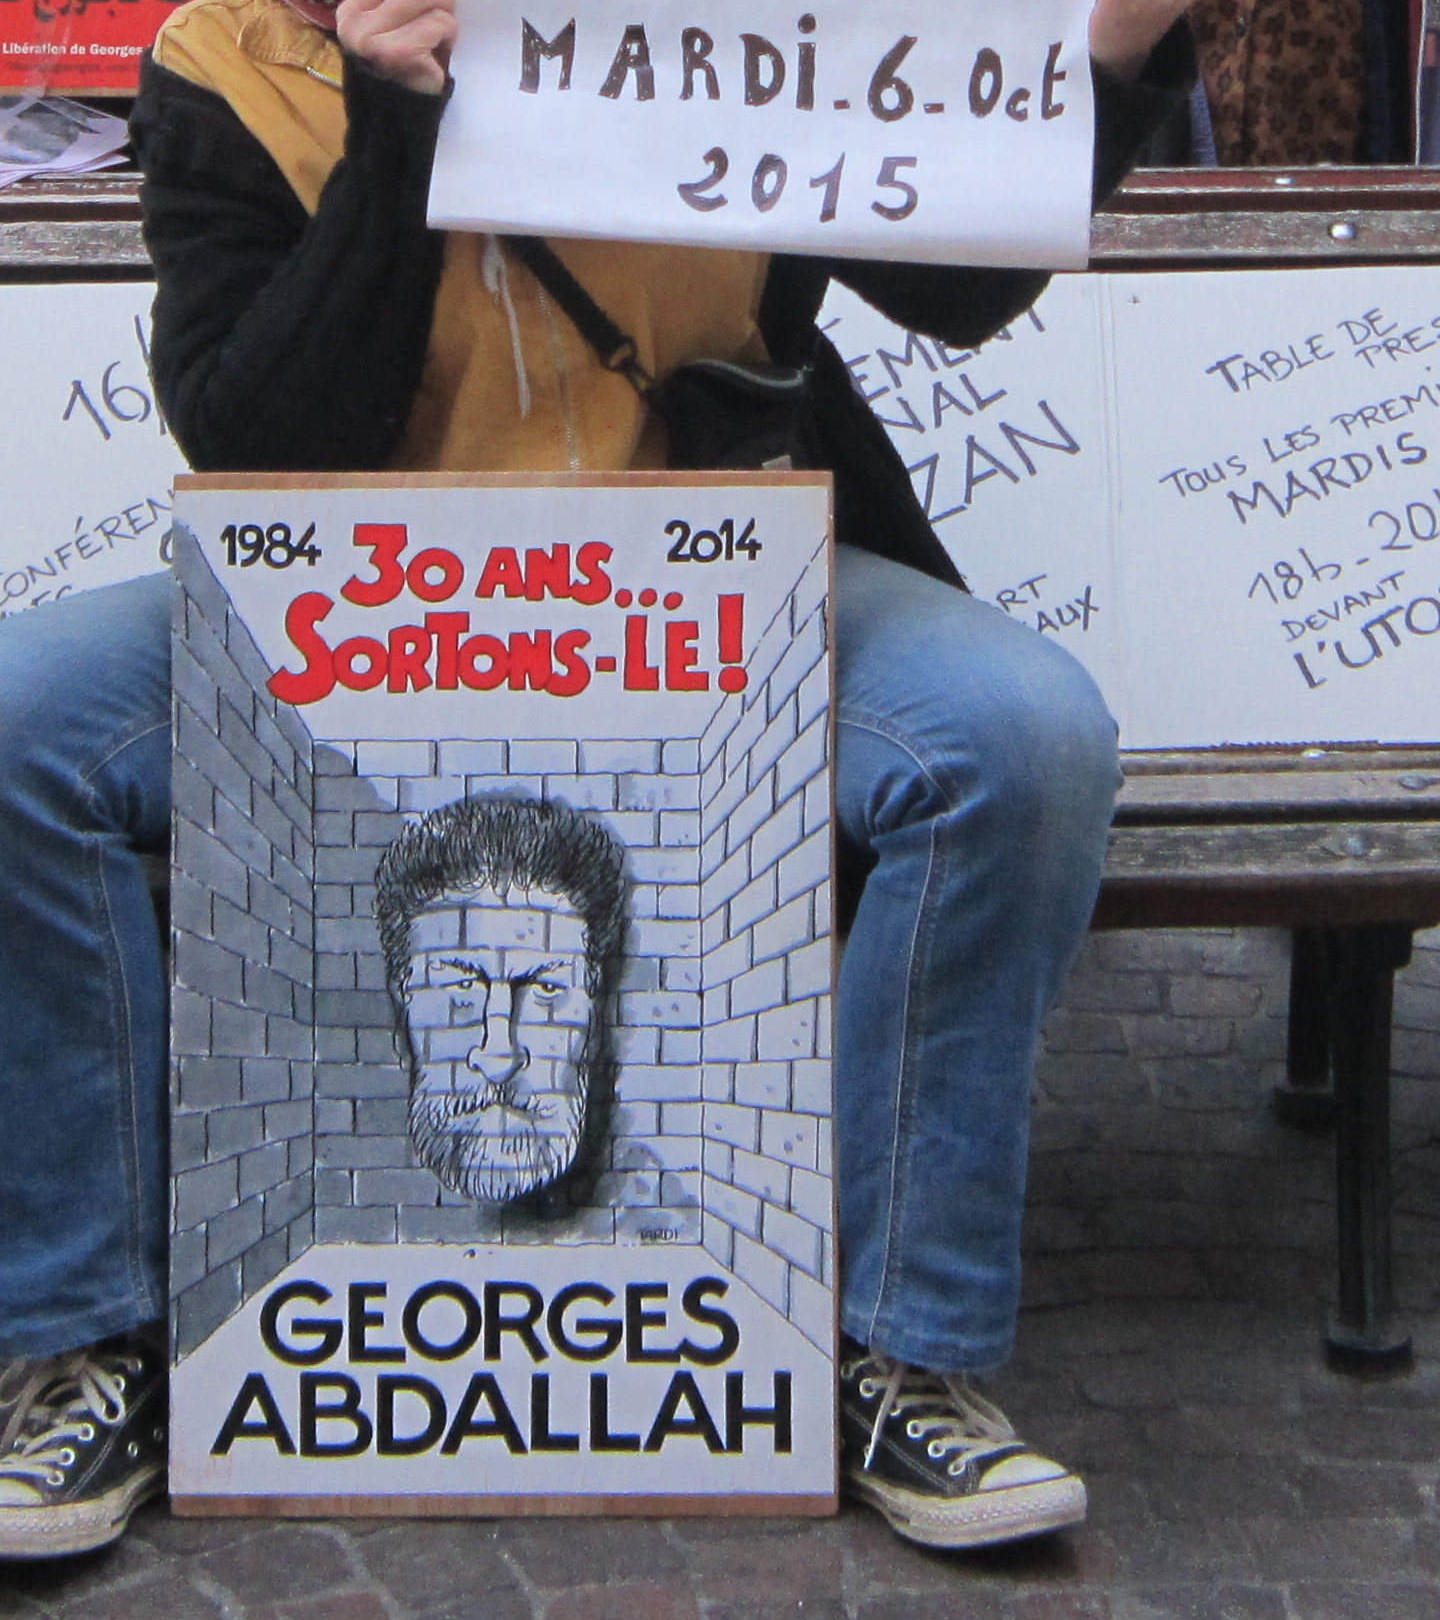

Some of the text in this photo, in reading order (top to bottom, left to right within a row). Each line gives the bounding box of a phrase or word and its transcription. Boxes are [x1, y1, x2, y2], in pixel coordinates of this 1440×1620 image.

[2, 41, 67, 56] Libération
[69, 42, 86, 55] de
[89, 43, 144, 58] Georges
[676, 145, 919, 223] 2015
[1205, 306, 1400, 394] TABLE DE
[907, 399, 1082, 525] ZAN
[1158, 454, 1248, 499] TOUS
[1262, 424, 1322, 464] LES
[1225, 430, 1429, 525] MARDIS
[220, 521, 323, 568] 1984
[340, 522, 683, 614] 30 ANS...
[663, 516, 763, 564] 2014
[1247, 546, 1343, 606] 18h
[996, 574, 1049, 613] RT
[1036, 584, 1100, 633] AUX
[1280, 570, 1406, 644] DEVANT
[258, 1275, 740, 1365] GEORGES
[209, 1369, 793, 1460] ABDALLAH
